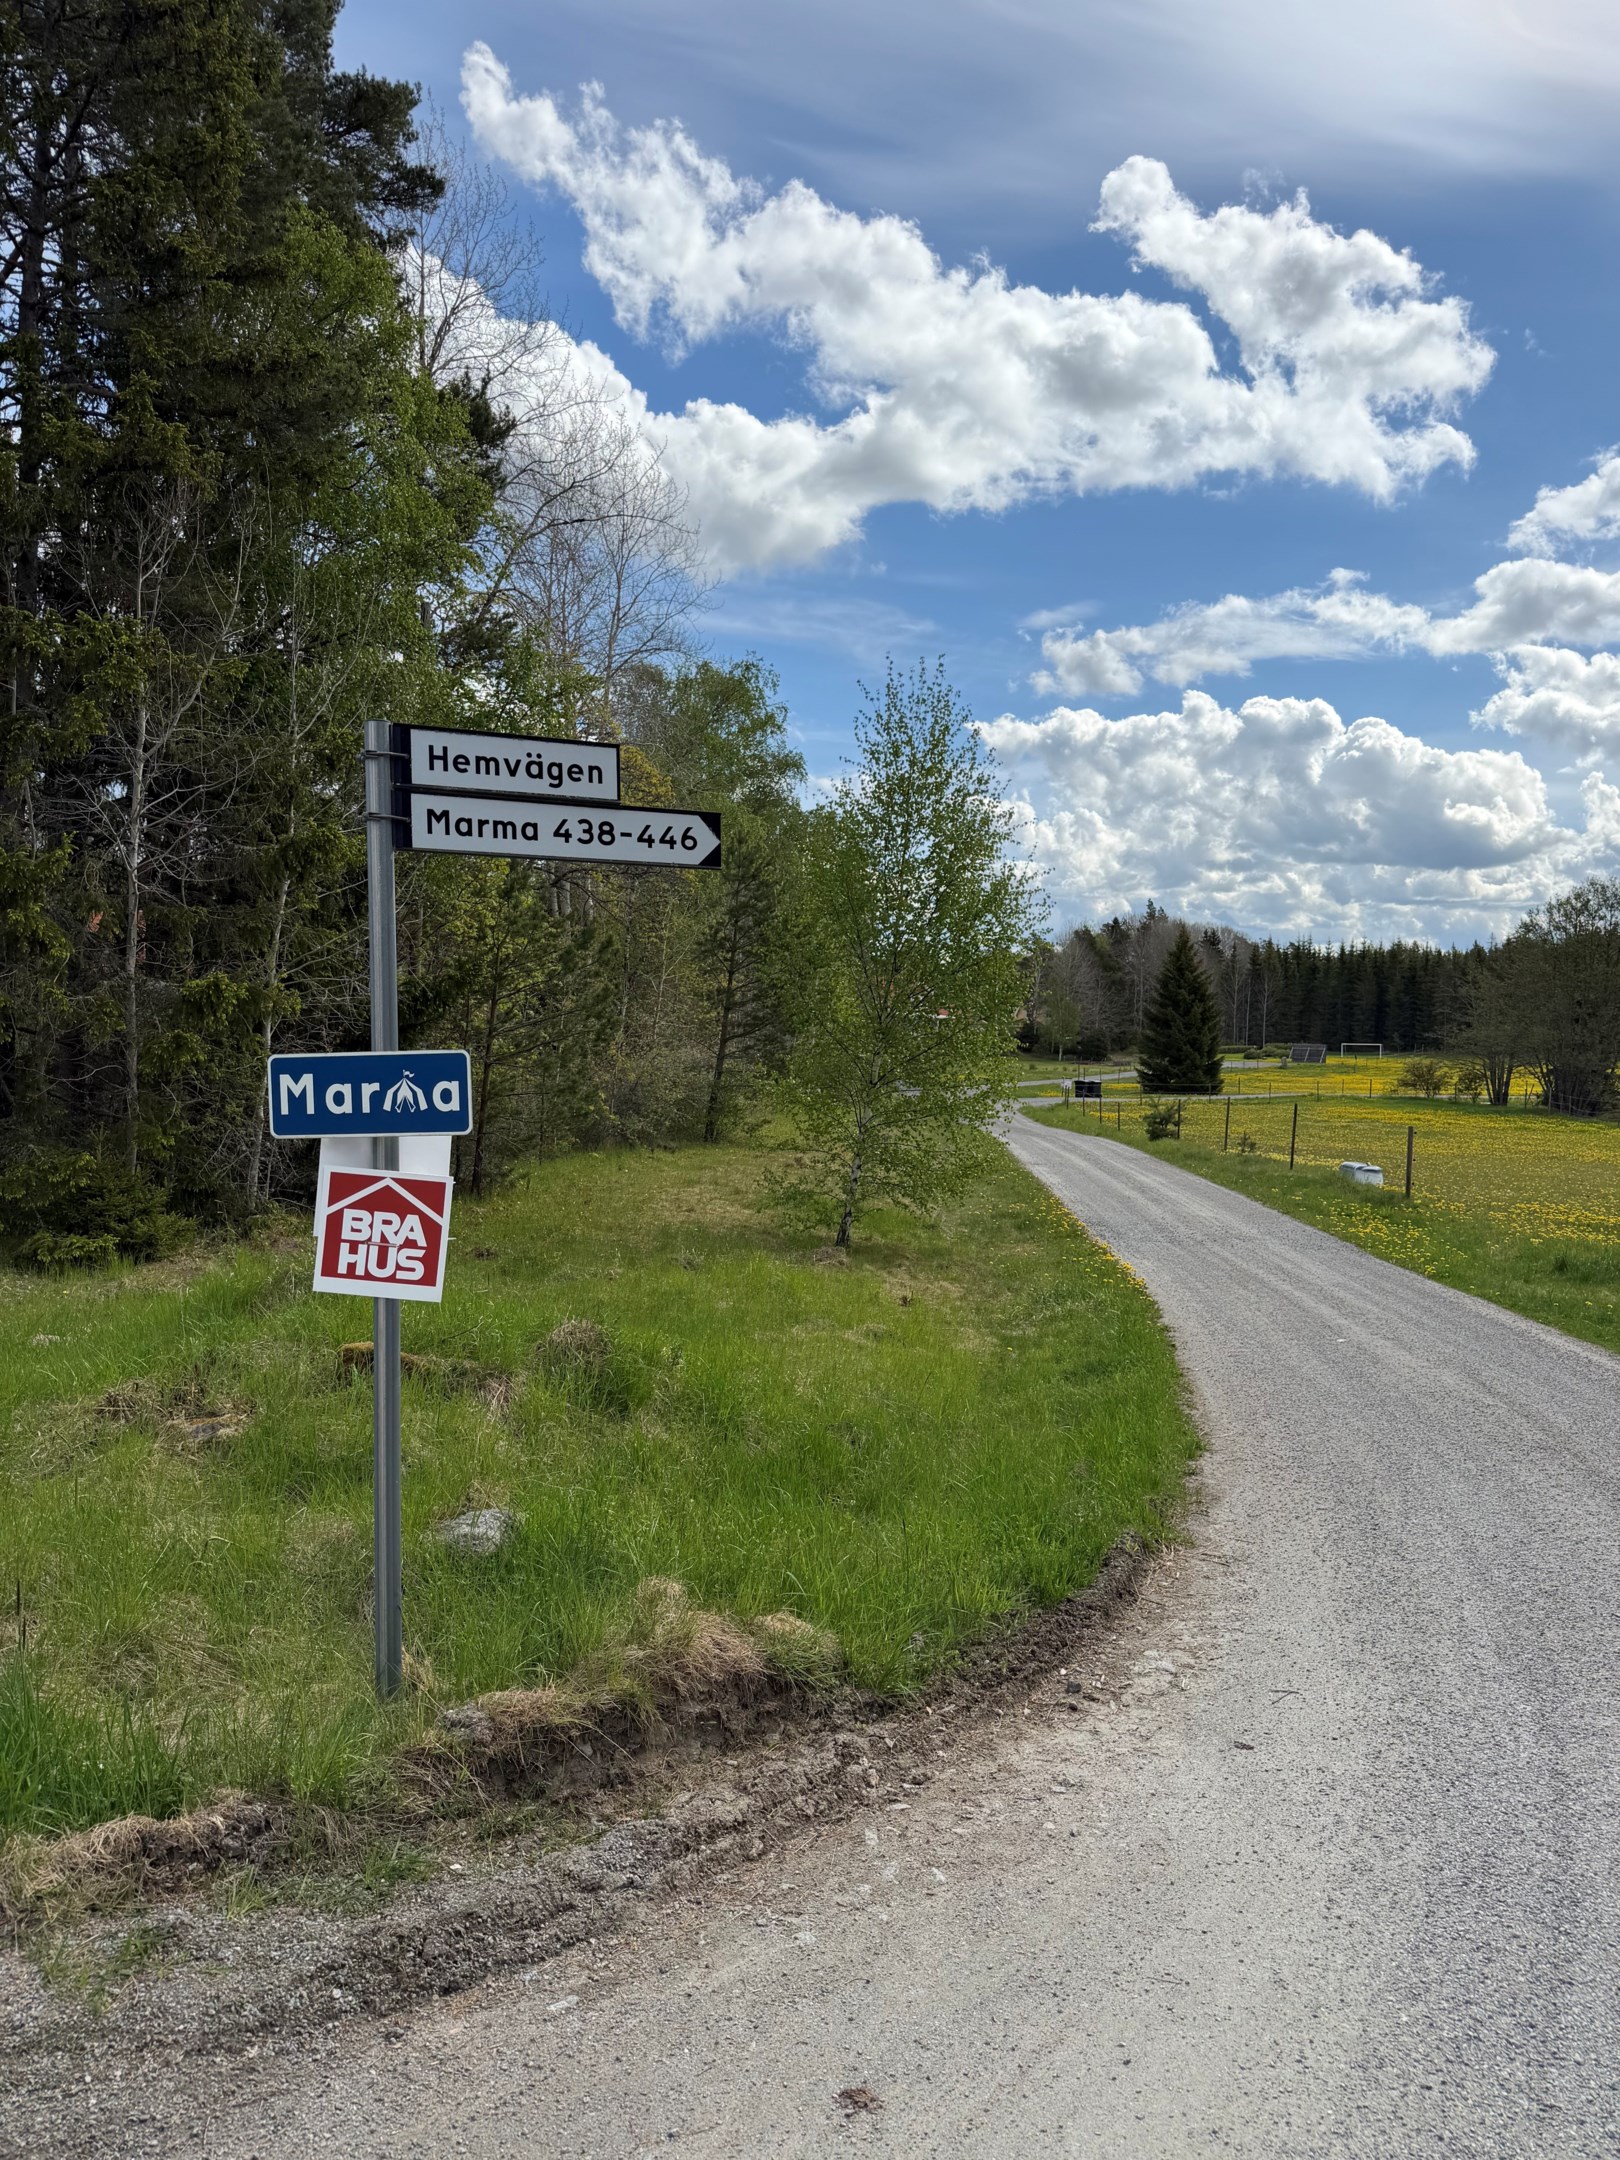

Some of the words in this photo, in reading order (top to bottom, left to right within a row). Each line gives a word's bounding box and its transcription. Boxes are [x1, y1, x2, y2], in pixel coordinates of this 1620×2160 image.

[428, 744, 603, 787] Hemvägen
[426, 808, 539, 841] Marma
[553, 818, 698, 850] 438-446
[341, 1208, 427, 1247] BRA
[337, 1242, 426, 1281] HUS
